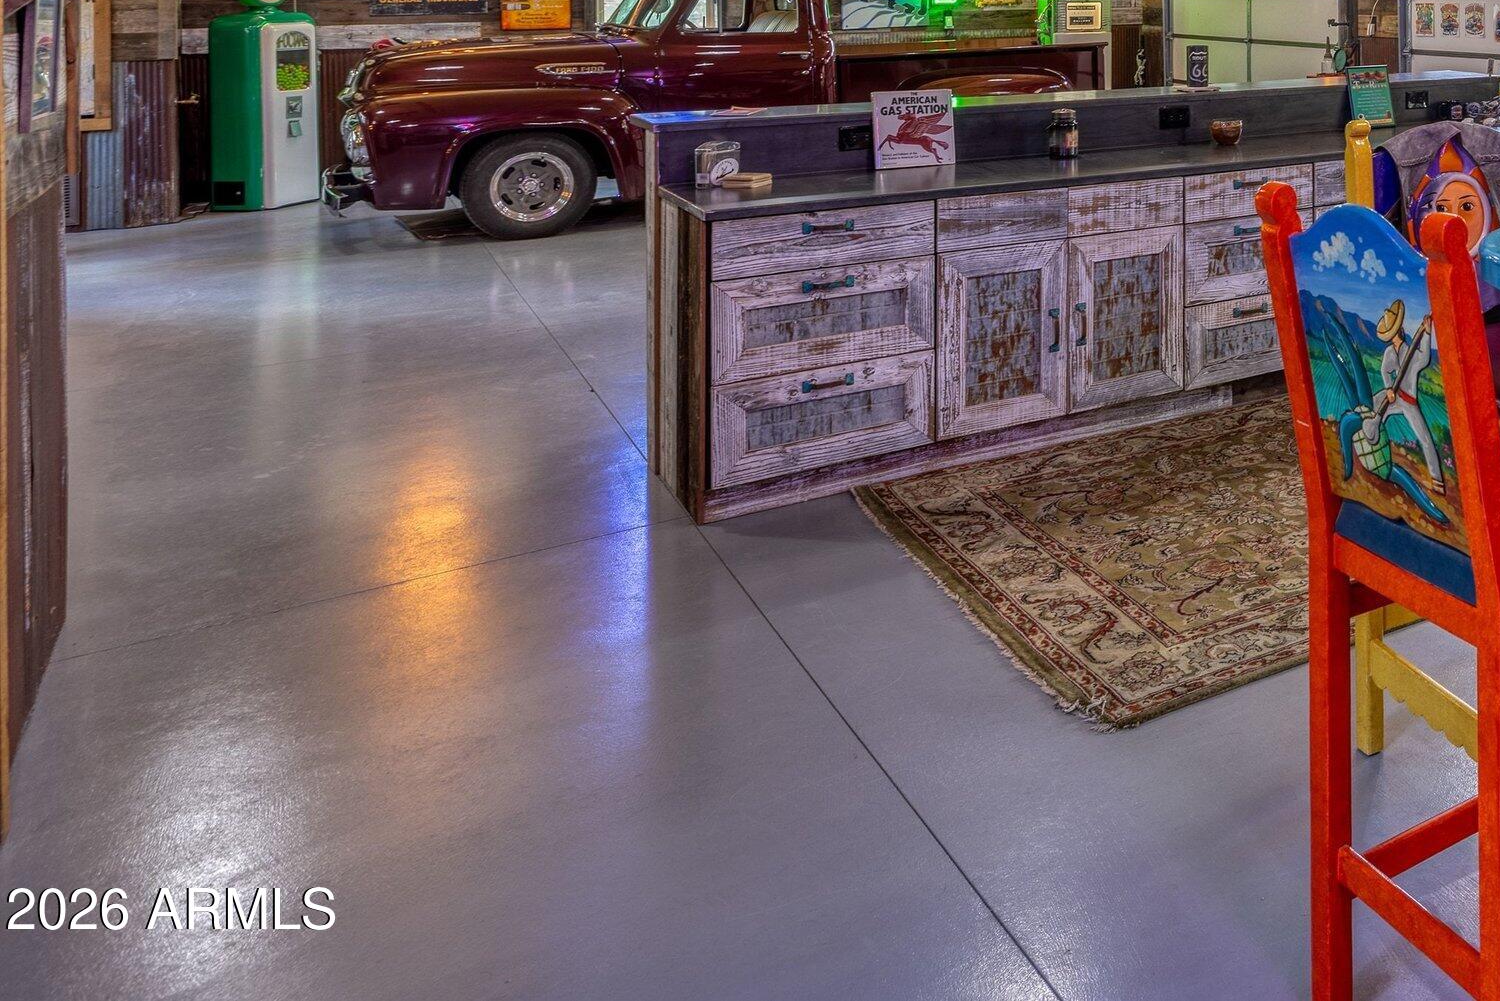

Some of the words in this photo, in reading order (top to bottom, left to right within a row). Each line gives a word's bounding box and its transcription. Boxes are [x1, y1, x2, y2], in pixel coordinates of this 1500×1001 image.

[891, 95, 938, 105] AMERICAN
[880, 105, 903, 116] GAS
[905, 103, 949, 115] STATION
